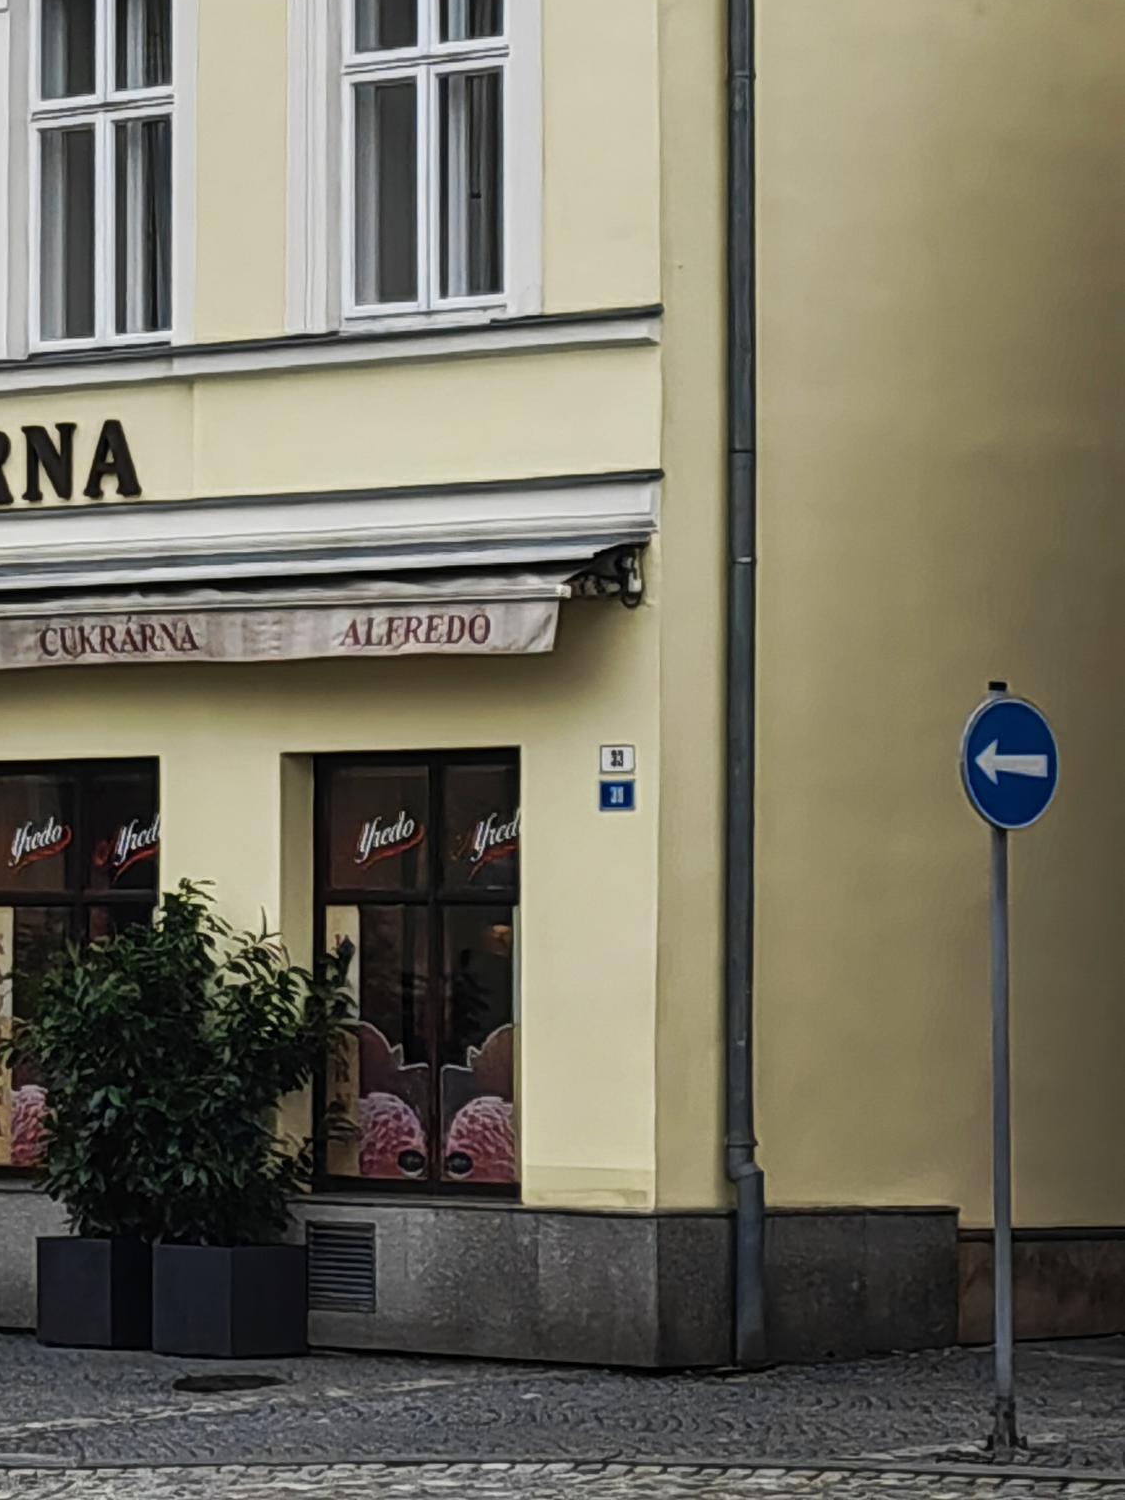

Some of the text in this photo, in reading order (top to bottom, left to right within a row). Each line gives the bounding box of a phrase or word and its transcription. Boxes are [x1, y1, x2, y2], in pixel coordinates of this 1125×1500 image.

[38, 615, 200, 658] CUKRÁRNA
[339, 613, 492, 646] ALFREDO
[7, 816, 63, 867] lfredo
[354, 810, 416, 863] lfredo
